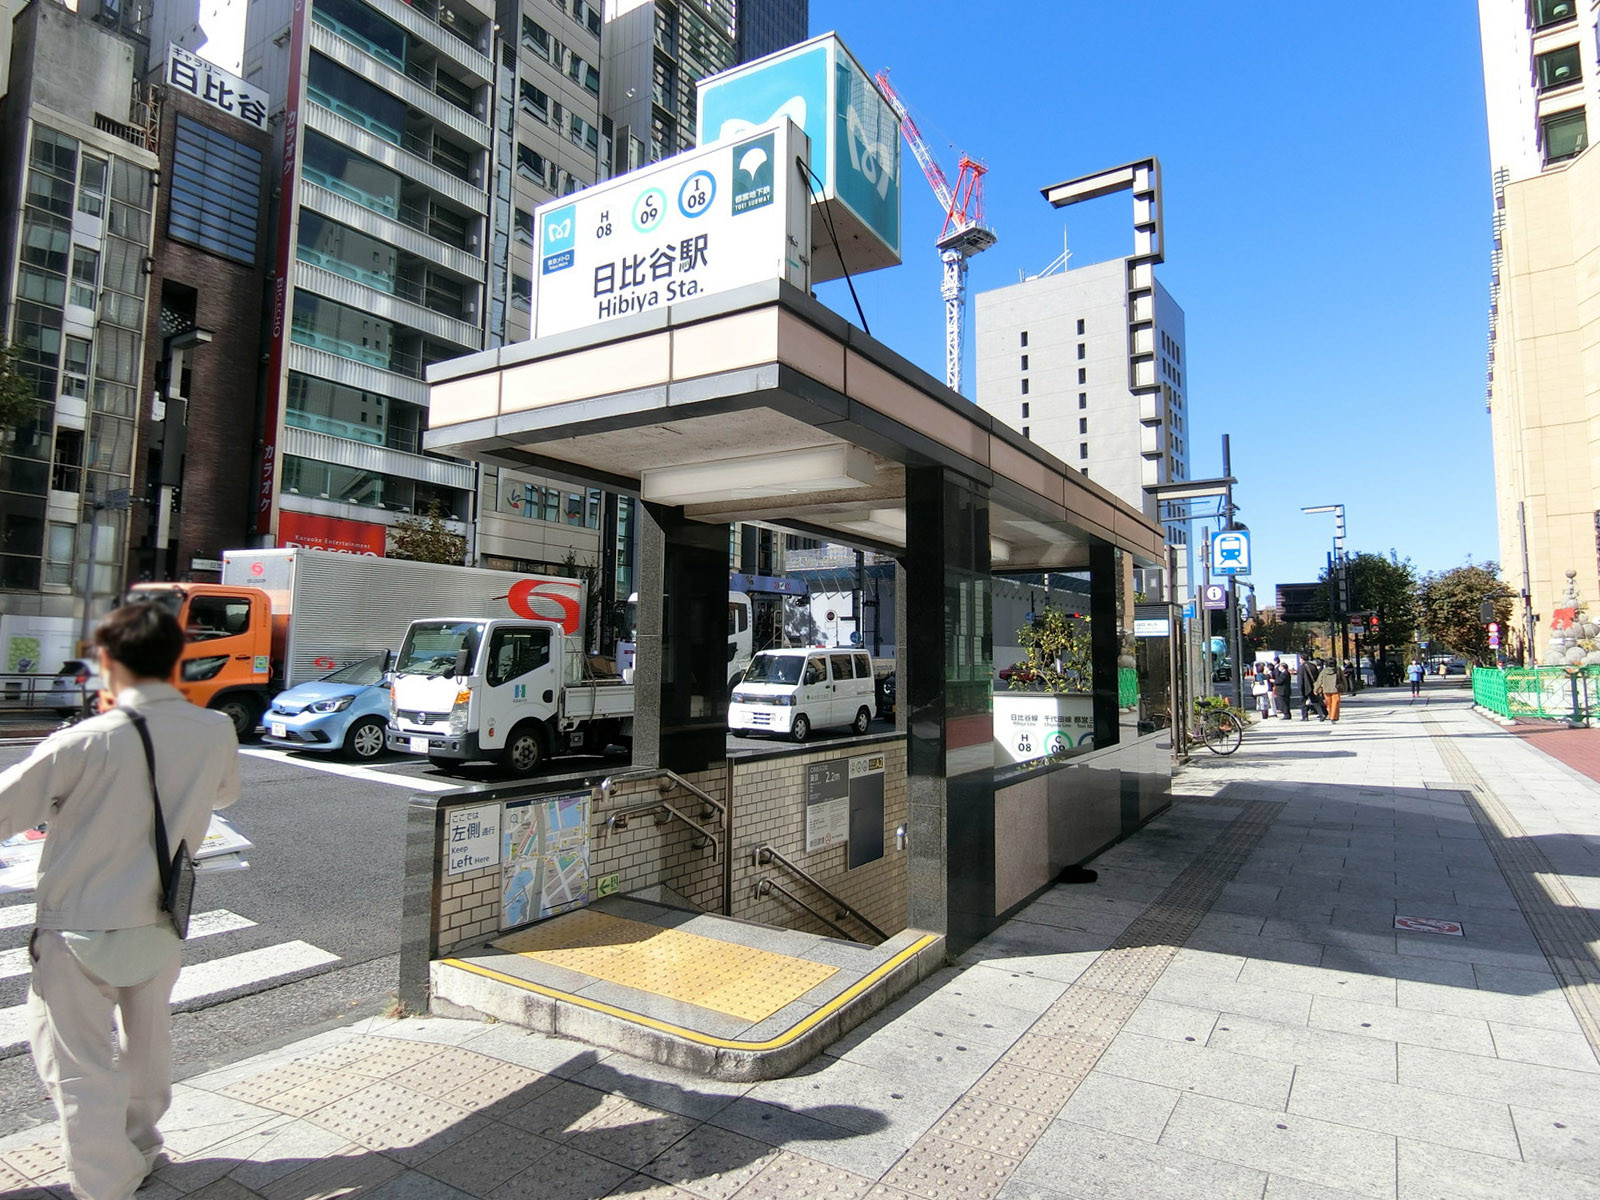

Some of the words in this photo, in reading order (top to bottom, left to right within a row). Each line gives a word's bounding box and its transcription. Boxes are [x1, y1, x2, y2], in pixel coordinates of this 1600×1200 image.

[173, 47, 222, 76] ギャラリー
[171, 57, 266, 127] 日比谷
[283, 110, 297, 175] カラオケ
[694, 178, 701, 192] I
[645, 194, 653, 207] C
[687, 192, 706, 209] 08
[735, 203, 747, 211] TOEI
[748, 195, 771, 207] SUBWAY
[600, 210, 609, 223] H
[640, 208, 658, 225] 09
[596, 223, 612, 239] 08
[593, 233, 709, 299] 日比谷駅
[598, 284, 659, 320] Hibiya
[666, 277, 705, 302] Sta.
[260, 444, 274, 513] カラオケ
[295, 534, 323, 544] Karaoke
[324, 538, 371, 549] Entertainment
[1010, 713, 1039, 722] 日比谷線
[1043, 715, 1072, 723] 千代田線
[1021, 733, 1029, 742] H
[1055, 735, 1062, 743] C
[1018, 743, 1032, 752] 08
[825, 771, 841, 783] 2.2m
[452, 811, 479, 822] ここでは
[451, 845, 469, 854] Keep
[451, 854, 473, 870] Left
[474, 855, 490, 864] Here
